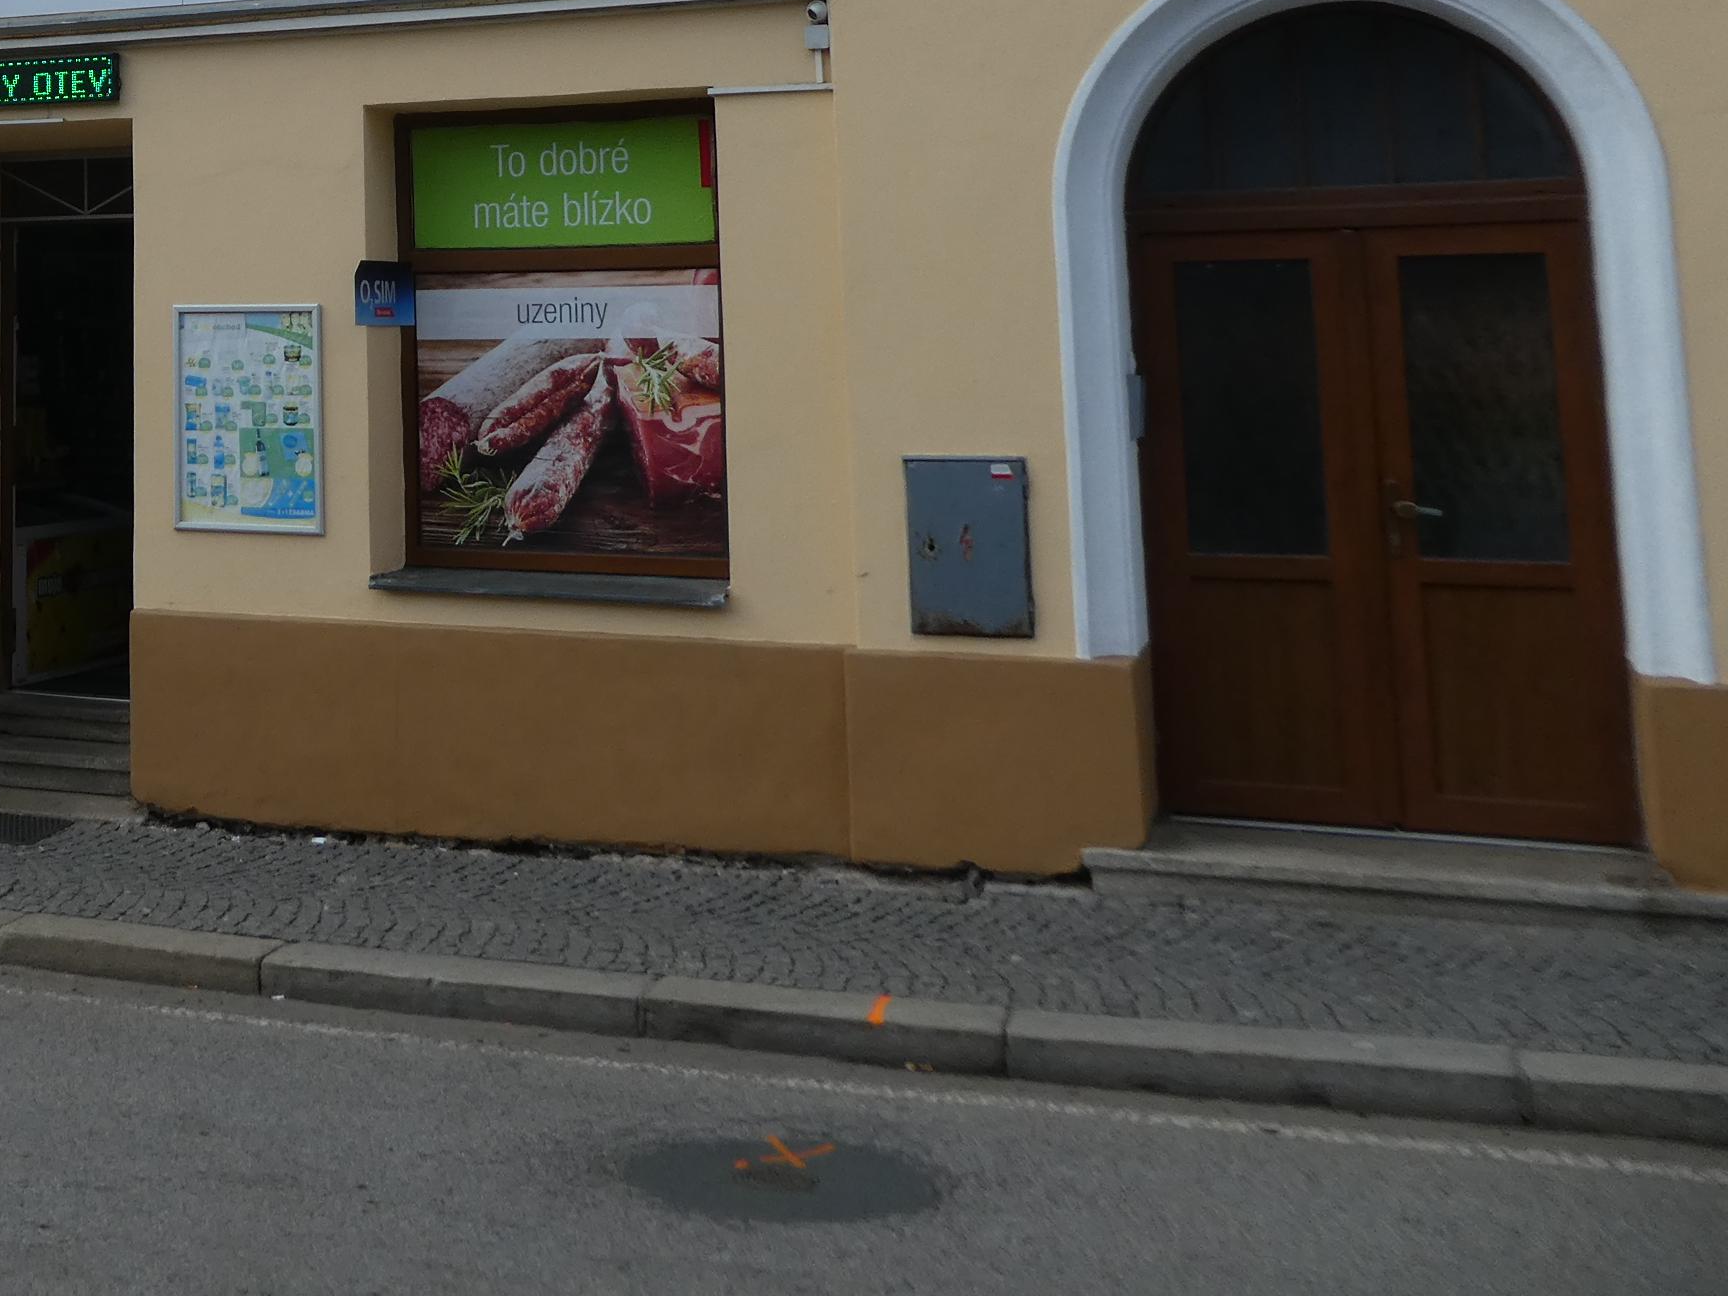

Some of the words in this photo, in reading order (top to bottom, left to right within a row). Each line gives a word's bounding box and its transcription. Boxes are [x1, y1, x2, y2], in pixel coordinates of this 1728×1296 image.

[33, 68, 108, 96] OTEV
[490, 144, 526, 178] To
[540, 139, 629, 176] dobré
[474, 194, 549, 229] máte
[563, 189, 652, 228] blízko
[517, 297, 608, 329] uzeniny
